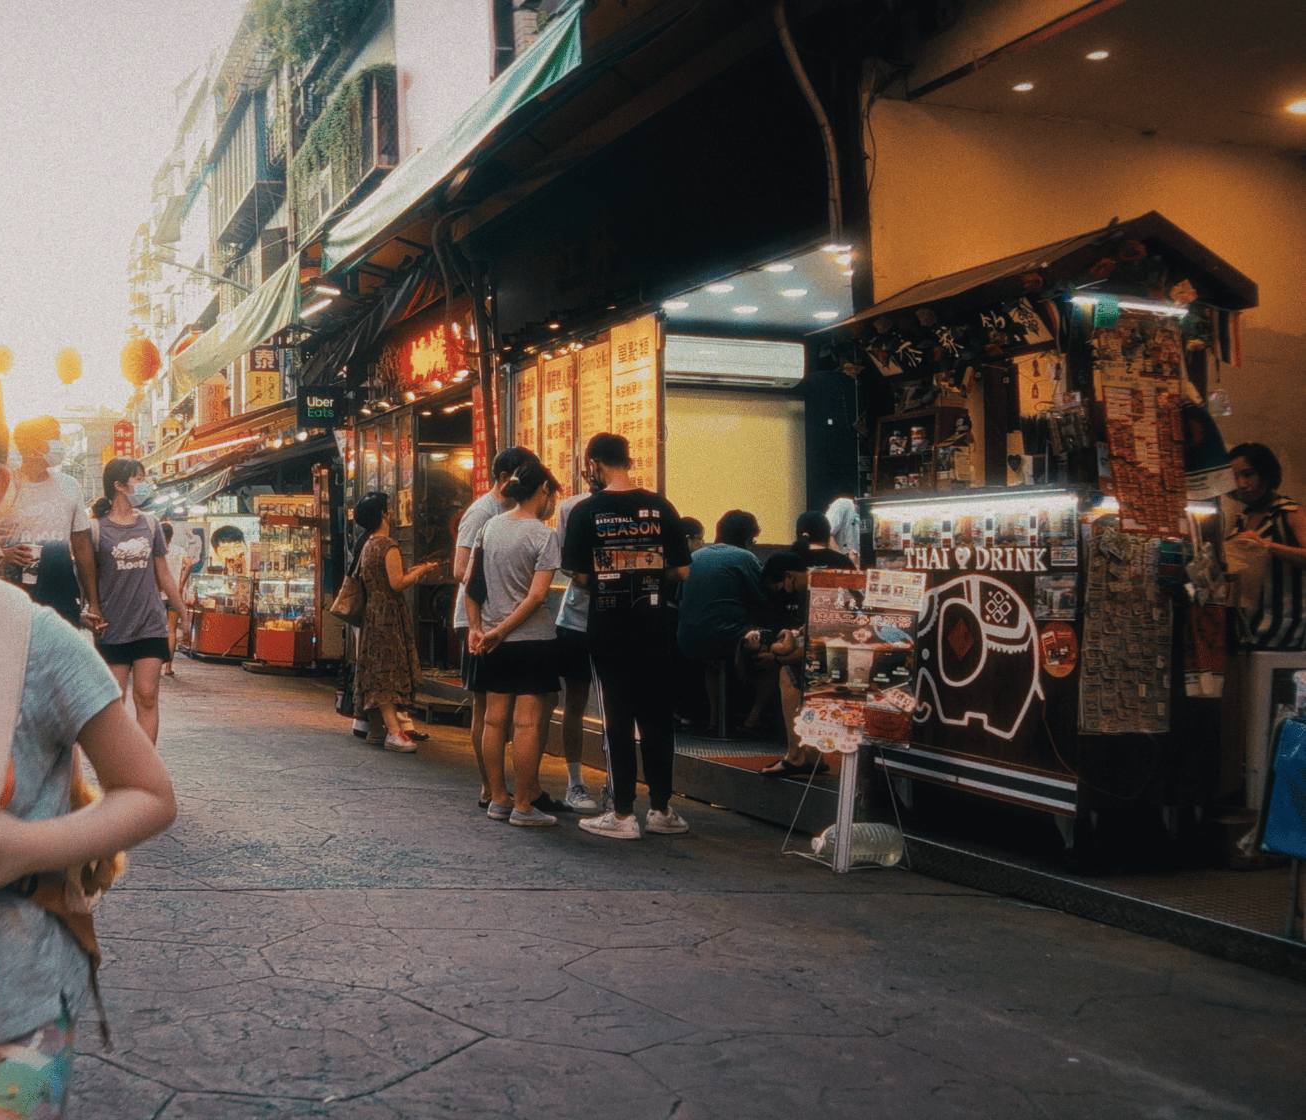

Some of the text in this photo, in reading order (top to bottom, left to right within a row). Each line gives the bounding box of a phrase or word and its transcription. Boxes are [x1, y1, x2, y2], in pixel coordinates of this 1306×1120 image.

[306, 396, 334, 408] Uber
[307, 407, 334, 418] Eats
[596, 517, 634, 525] BASKETBALL
[596, 522, 661, 537] SEASON
[904, 547, 1048, 572] THAI DRINK
